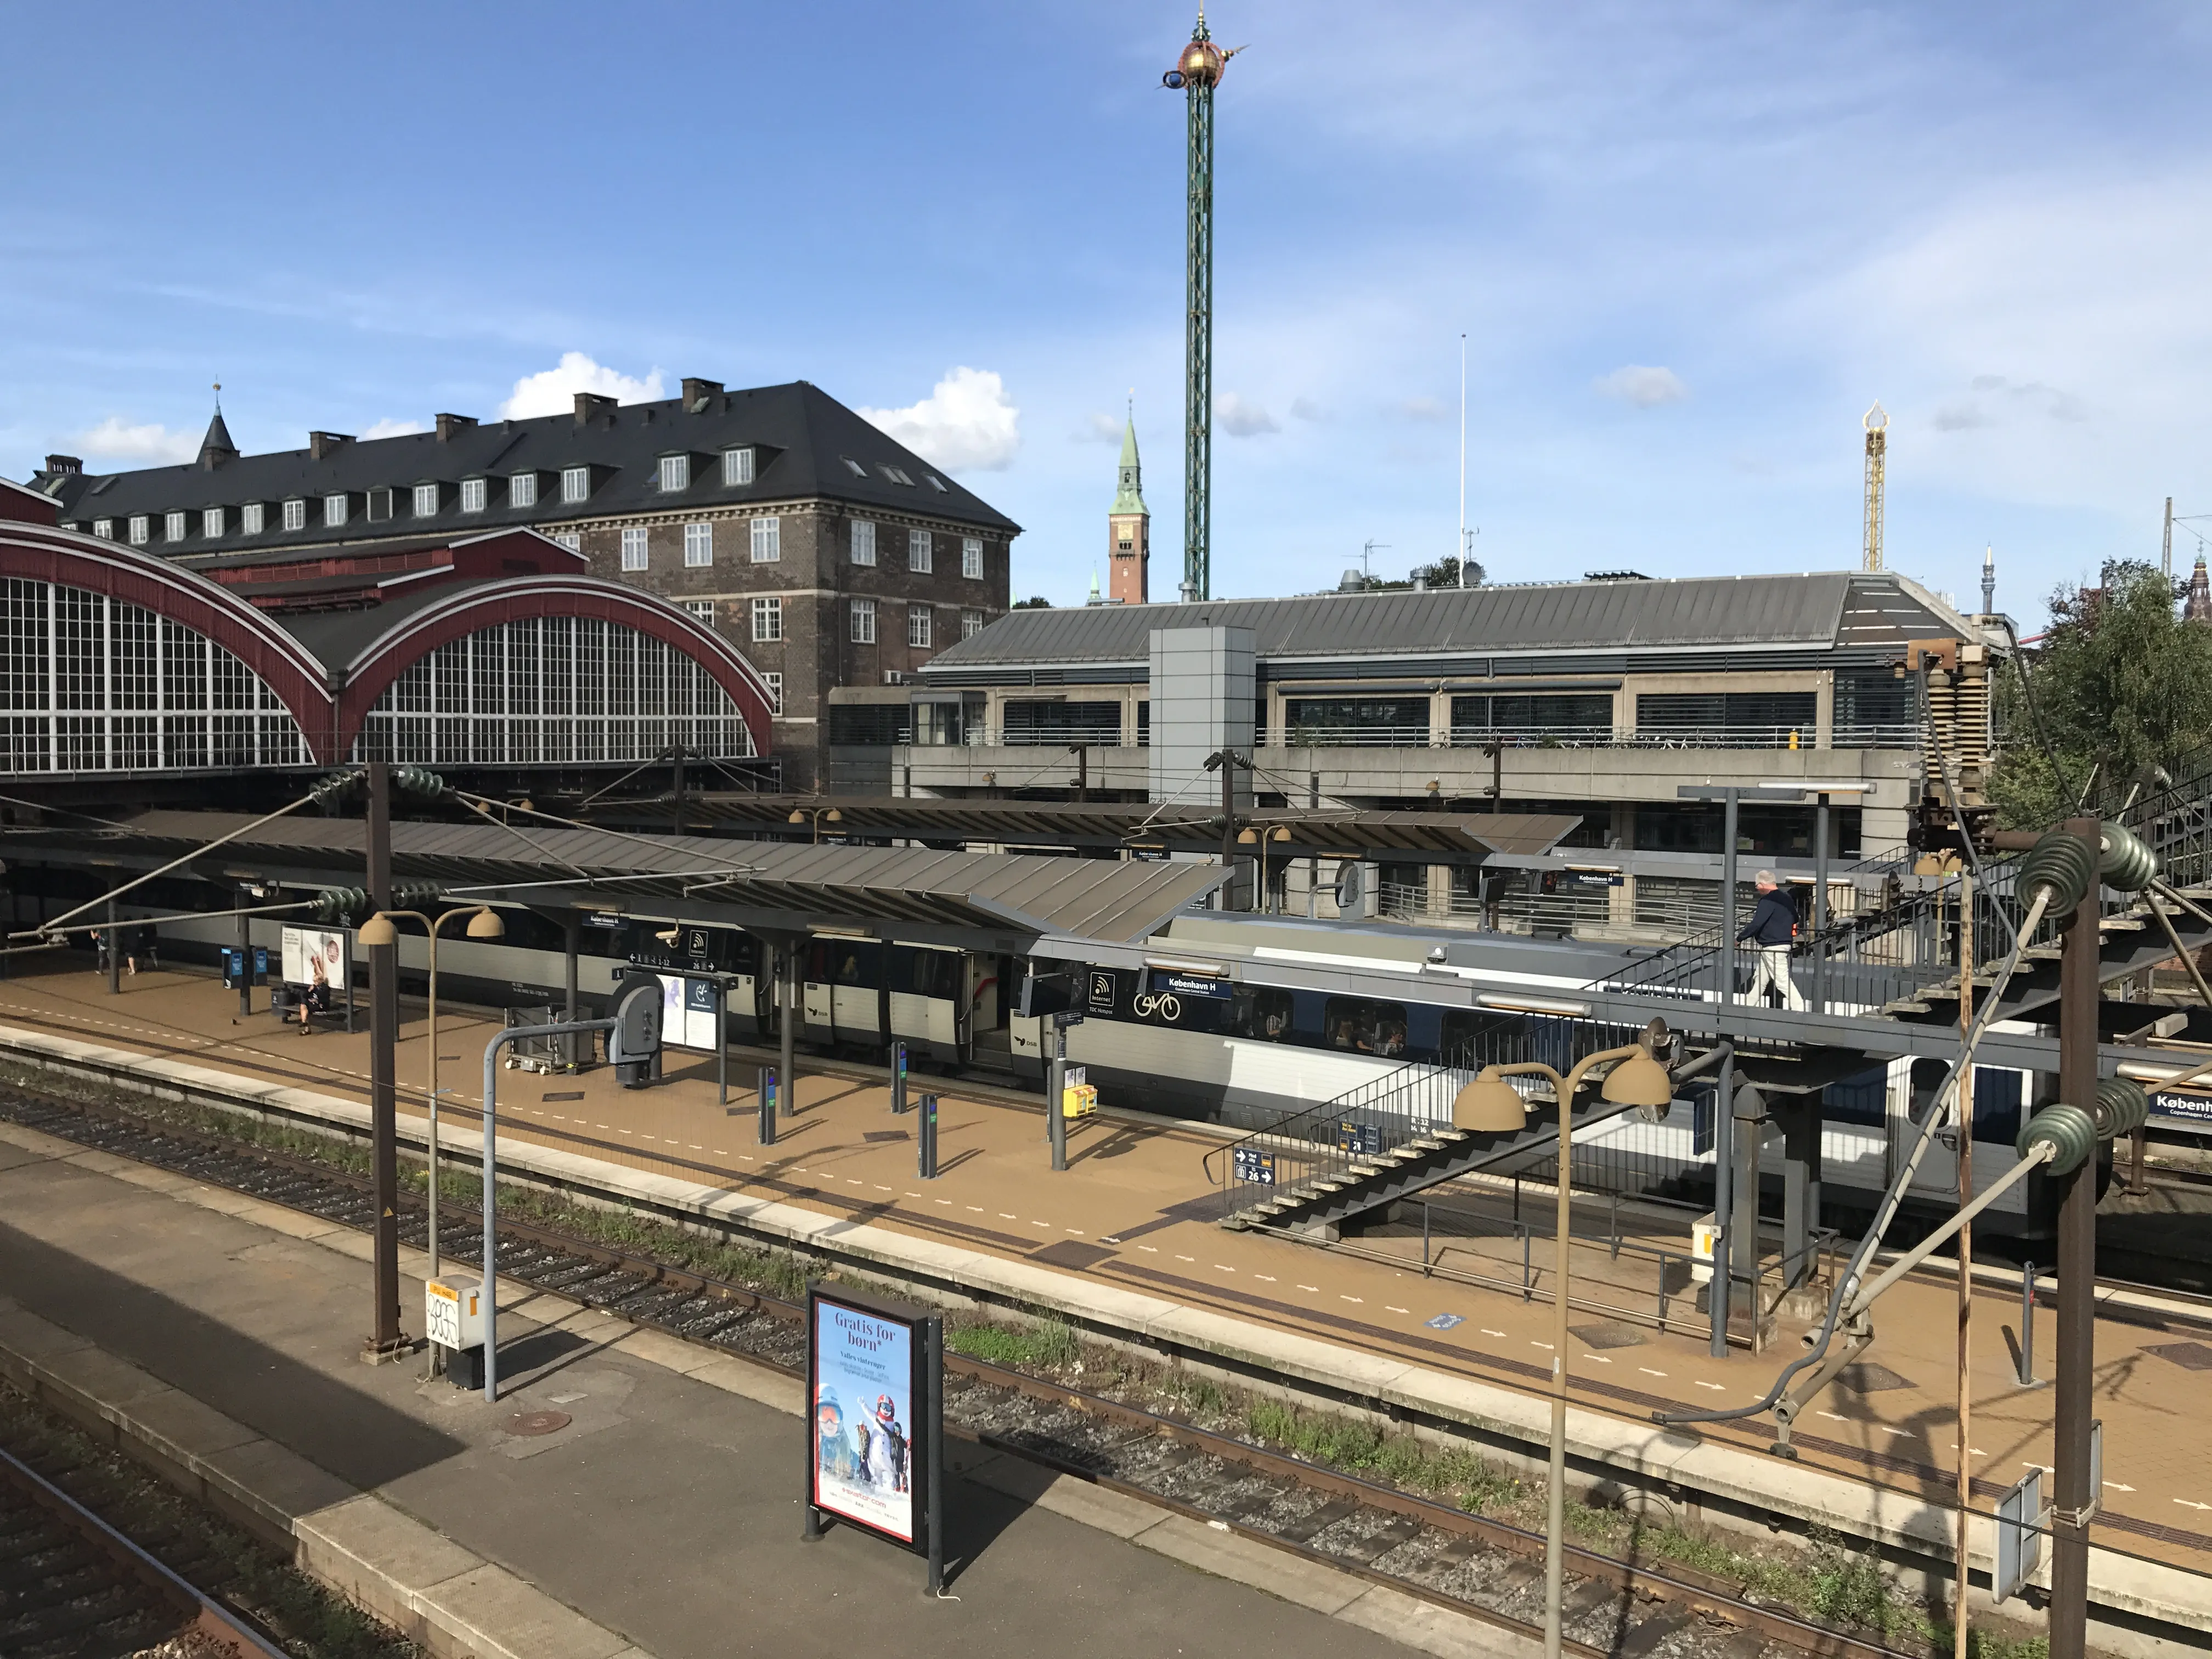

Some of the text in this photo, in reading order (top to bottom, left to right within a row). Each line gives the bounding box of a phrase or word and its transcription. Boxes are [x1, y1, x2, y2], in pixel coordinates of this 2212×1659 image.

[1169, 978, 1216, 991] København H
[2170, 1109, 2203, 1118] Copenhagen
[1248, 1170, 1259, 1182] 26
[835, 1312, 896, 1341] Gratis for
